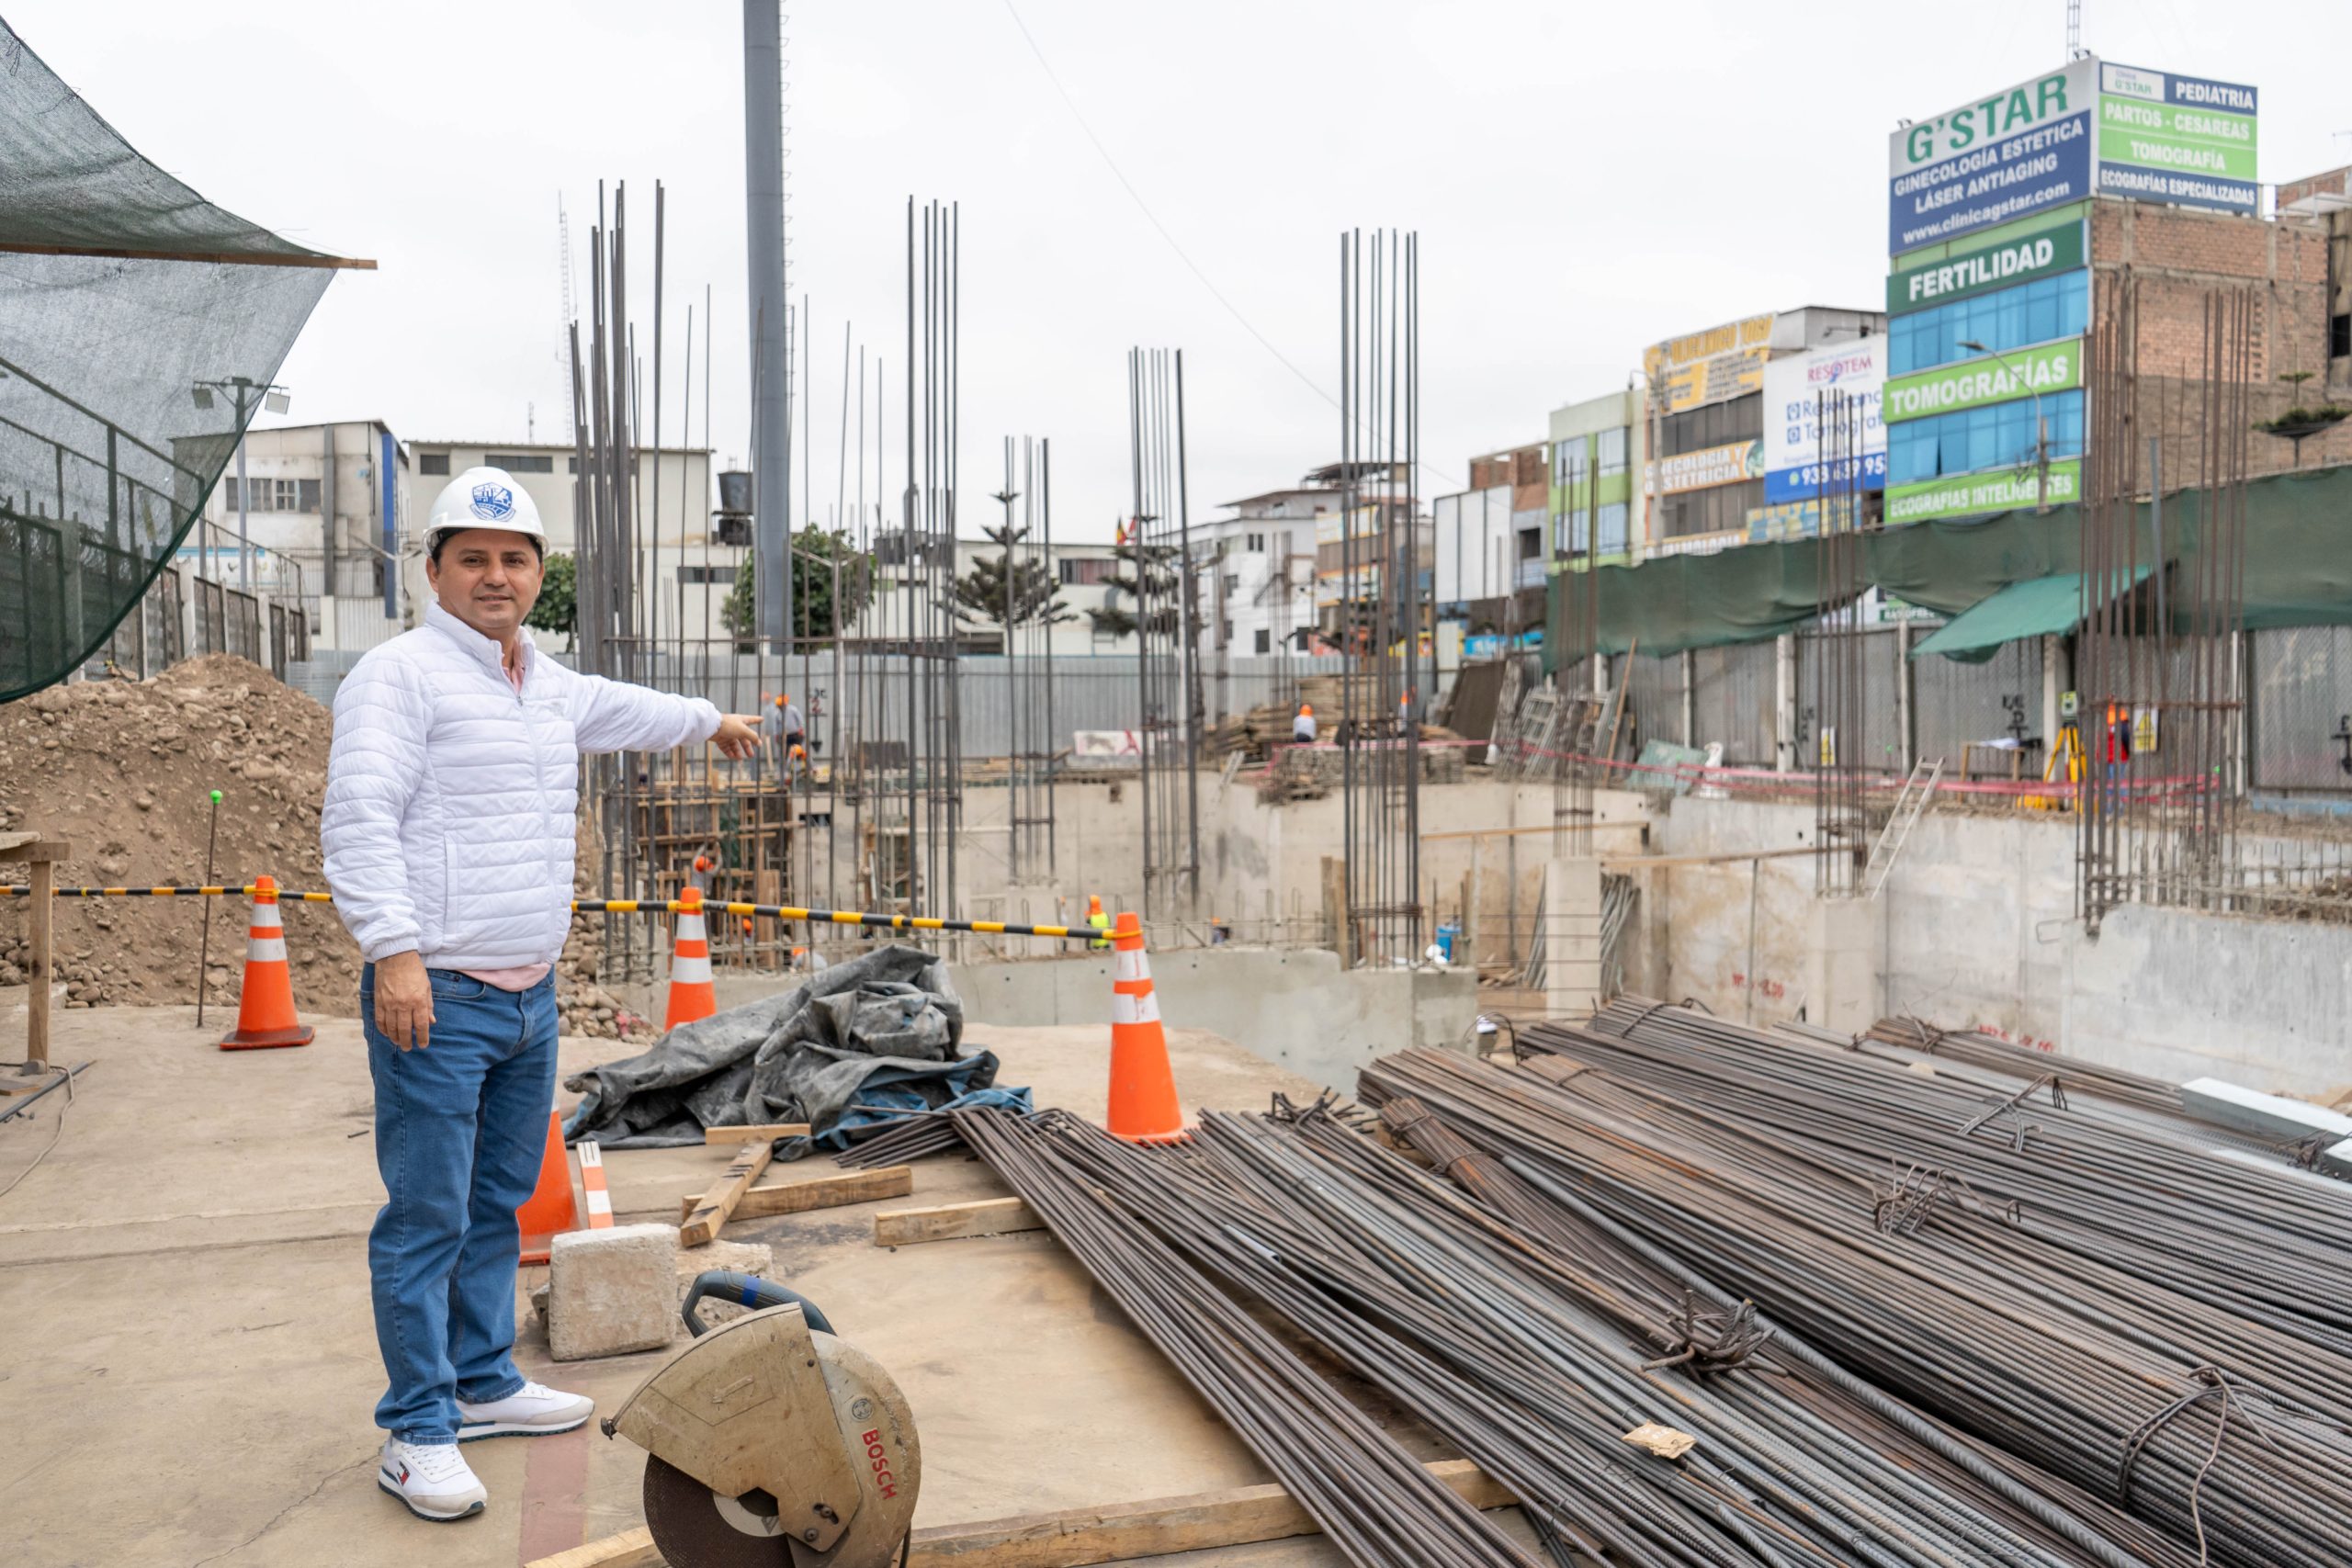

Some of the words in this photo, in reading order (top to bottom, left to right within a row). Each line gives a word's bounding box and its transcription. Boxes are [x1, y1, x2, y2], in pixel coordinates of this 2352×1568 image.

[2176, 81, 2255, 109] PEDIATRIA
[1907, 74, 2068, 164] G'STAR
[2002, 118, 2084, 162] ESTETICA
[2105, 102, 2162, 129] PARTOS
[2175, 114, 2250, 141] CESAREAS
[1967, 152, 2058, 198] ANTIAGING
[2169, 178, 2255, 206] ESPECIALIZADAS
[1903, 182, 2070, 243] www.clinicagstar.com
[1909, 238, 2053, 302] FERTILIDAD
[1807, 355, 1872, 384] RESOTEM
[1890, 355, 2068, 415] TOMOGRAFÍAS
[1973, 474, 2073, 506] INTELIGETES
[862, 1428, 898, 1500] BOSCH
